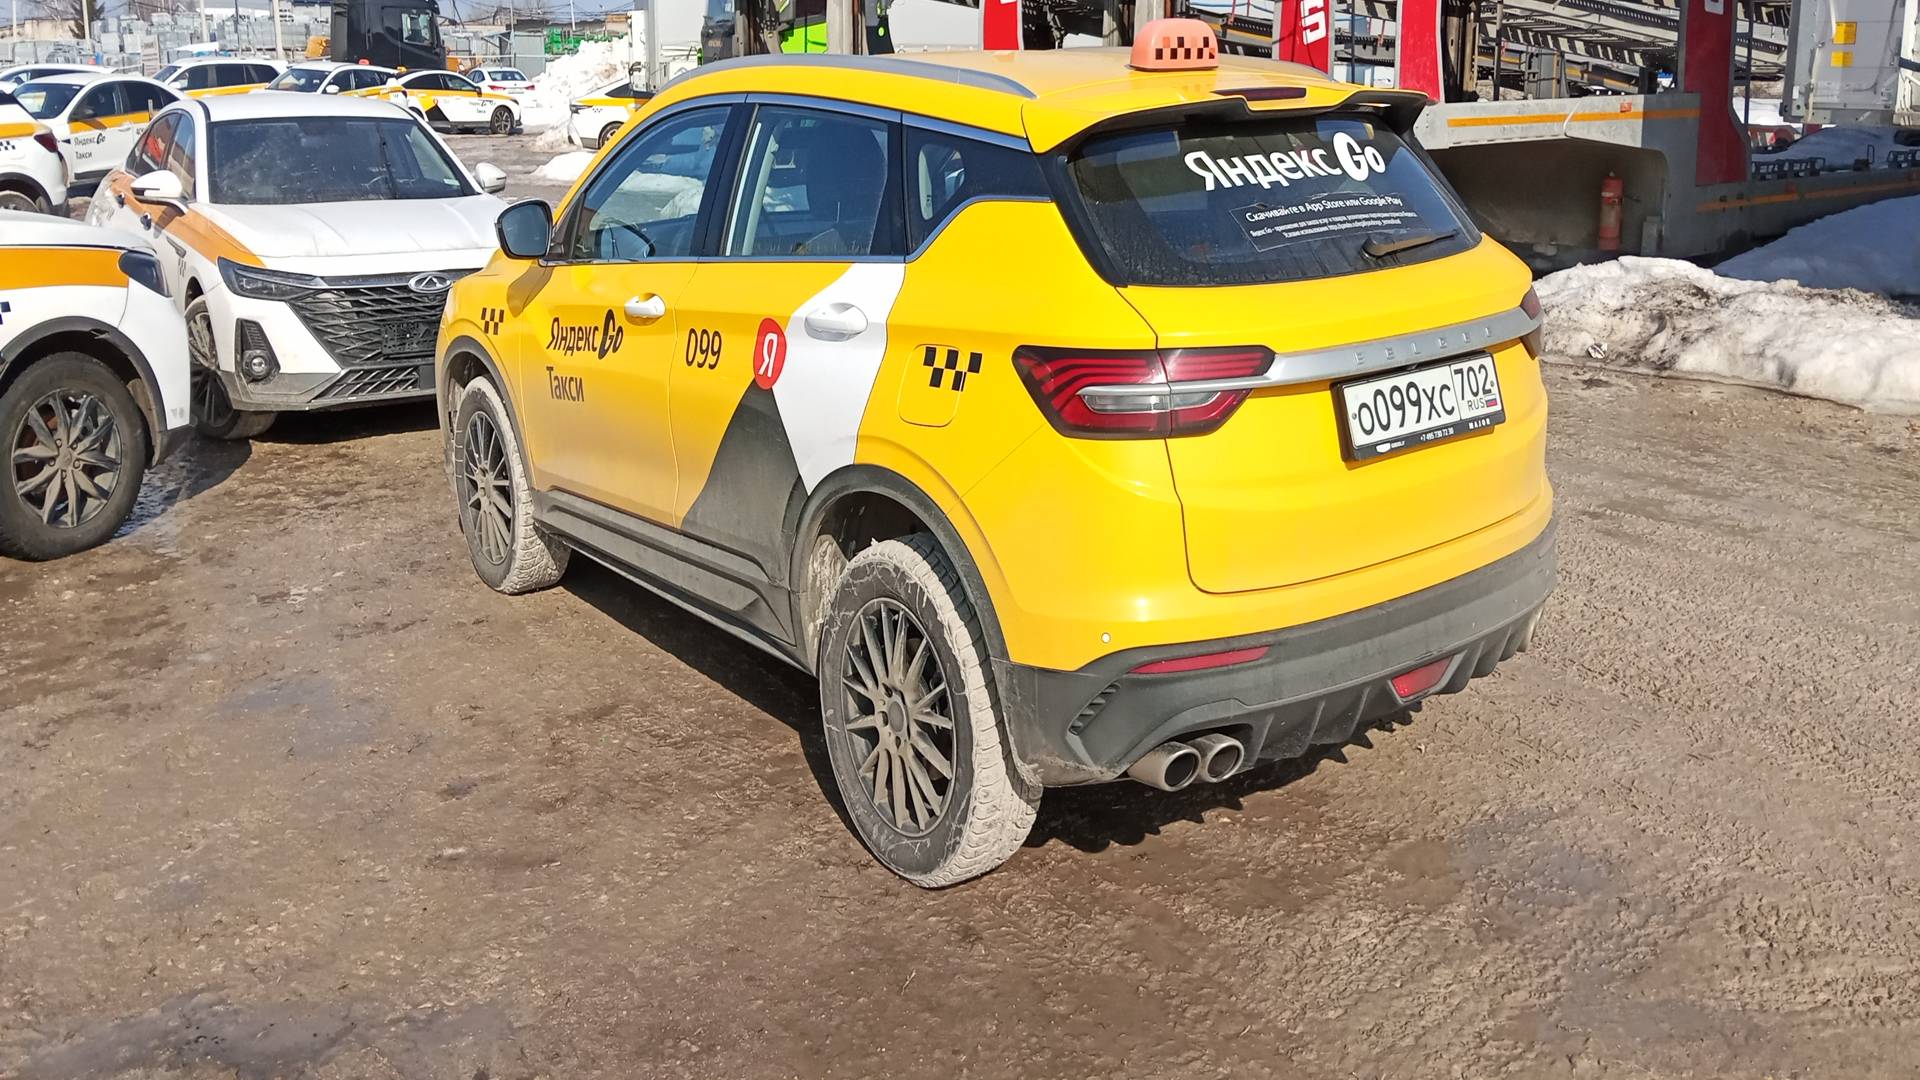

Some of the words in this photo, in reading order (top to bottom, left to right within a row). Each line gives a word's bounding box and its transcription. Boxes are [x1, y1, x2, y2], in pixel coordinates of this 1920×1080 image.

[75, 151, 92, 160] Такси
[1184, 148, 1343, 191] Яндекс
[1333, 131, 1386, 182] Go
[1245, 206, 1299, 223] Скачивайте
[1299, 204, 1307, 213] в
[1306, 201, 1325, 213] App
[1323, 200, 1346, 211] Store
[1345, 199, 1360, 208] или
[1359, 195, 1386, 207] Google
[1385, 195, 1403, 207] Play
[545, 316, 599, 358] Яндекс
[598, 309, 624, 360] Go
[685, 328, 722, 370] 099
[758, 332, 779, 377] Я
[546, 365, 585, 403] Такси
[1453, 364, 1492, 401] 702
[1467, 394, 1486, 412] RUS
